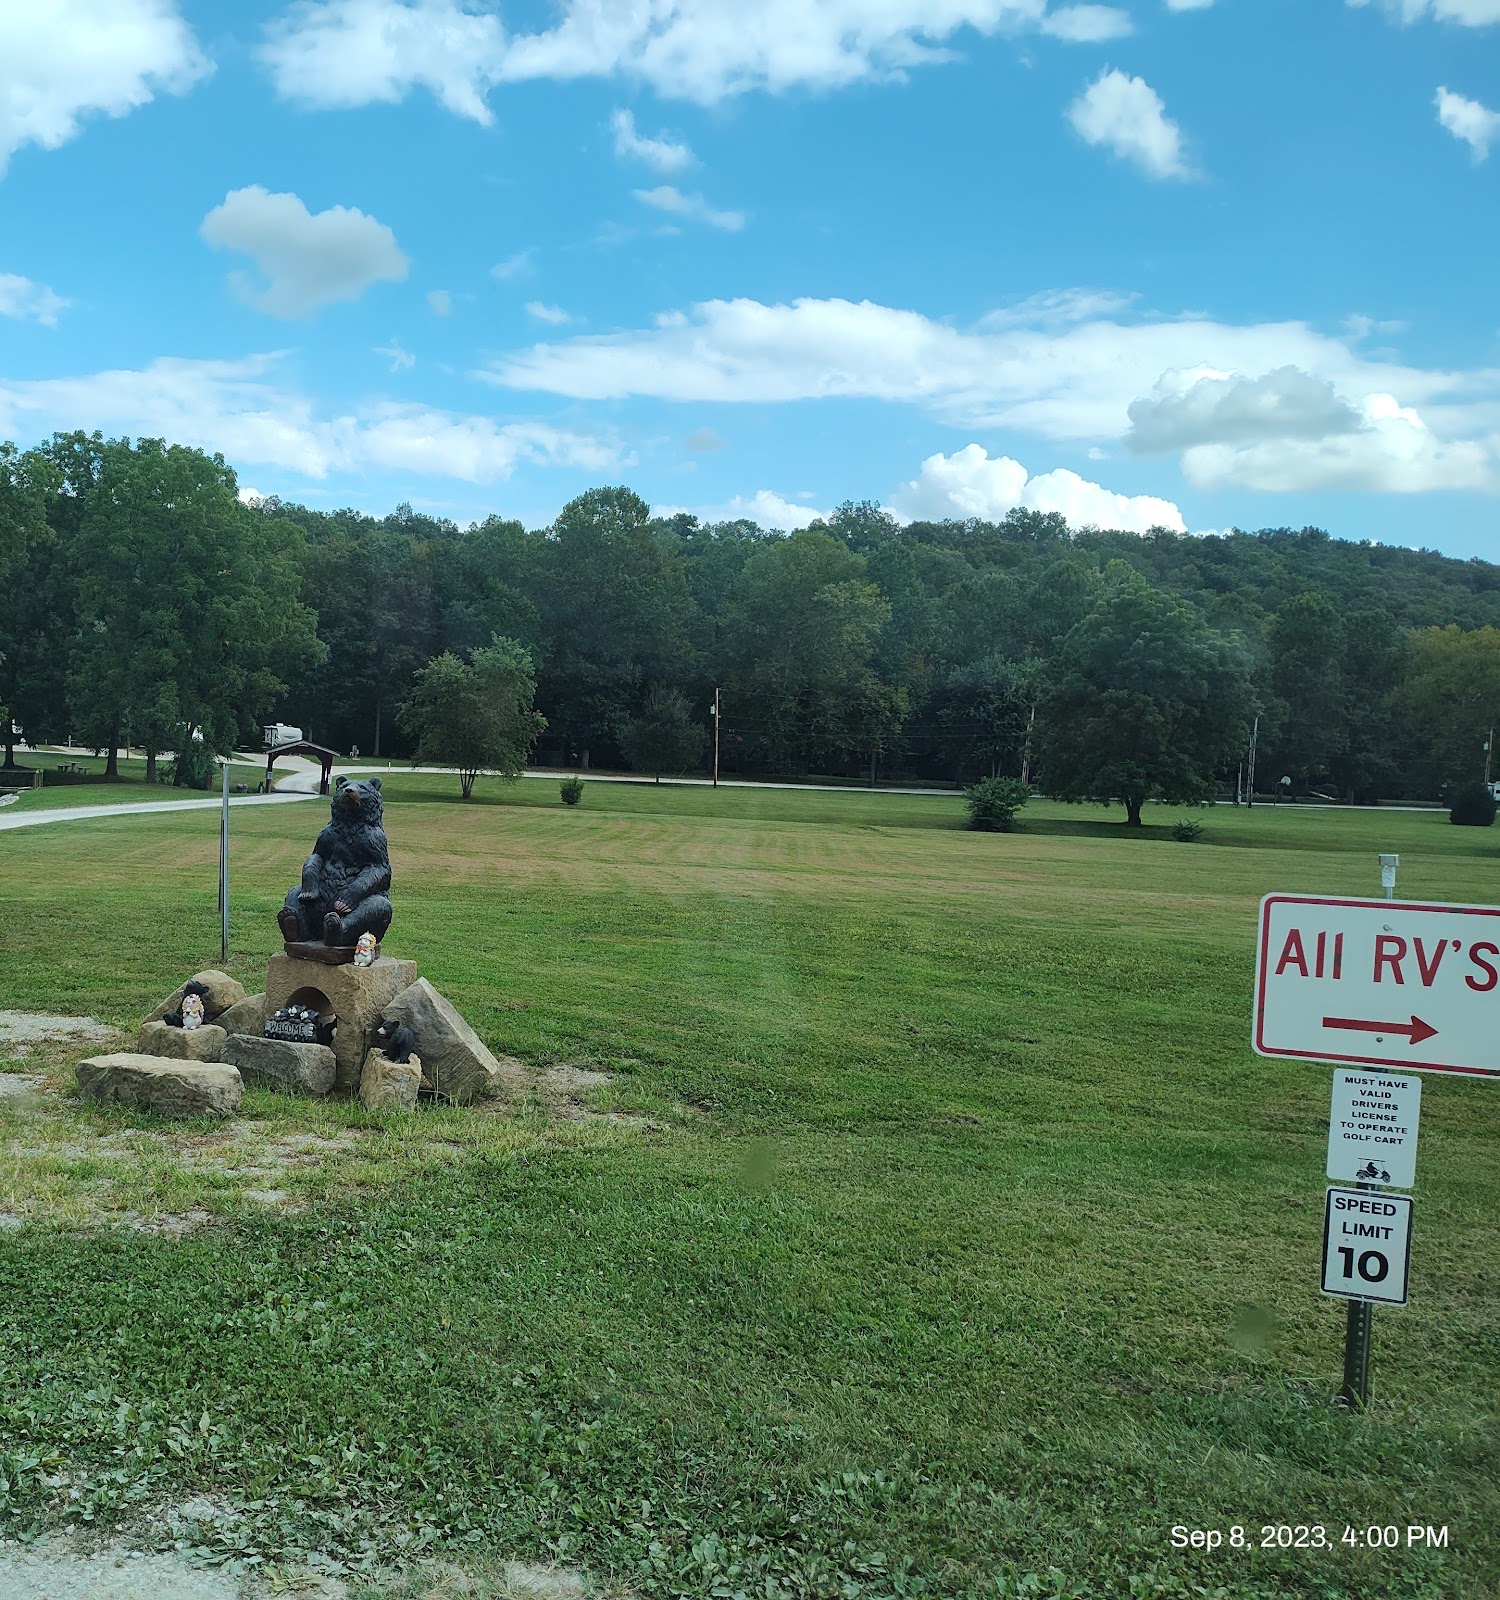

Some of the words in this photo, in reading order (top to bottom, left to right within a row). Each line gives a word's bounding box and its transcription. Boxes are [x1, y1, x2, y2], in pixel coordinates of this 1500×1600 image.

[1275, 928, 1344, 980] All
[1373, 934, 1500, 992] RV'S
[270, 1022, 305, 1034] WELCOME
[1344, 1076, 1375, 1086] MUST
[1378, 1080, 1408, 1089] HAVE
[1360, 1089, 1392, 1099] VALID
[1352, 1100, 1399, 1111] DRIVERS
[1352, 1111, 1397, 1122] LICENSE
[1340, 1121, 1354, 1129] TO
[1358, 1123, 1408, 1134] OPERATE
[1343, 1132, 1371, 1142] GOLF
[1374, 1136, 1403, 1145] CART
[1335, 1197, 1397, 1216] SPEED
[1342, 1221, 1393, 1240] LIMIT
[1338, 1246, 1389, 1283] 10
